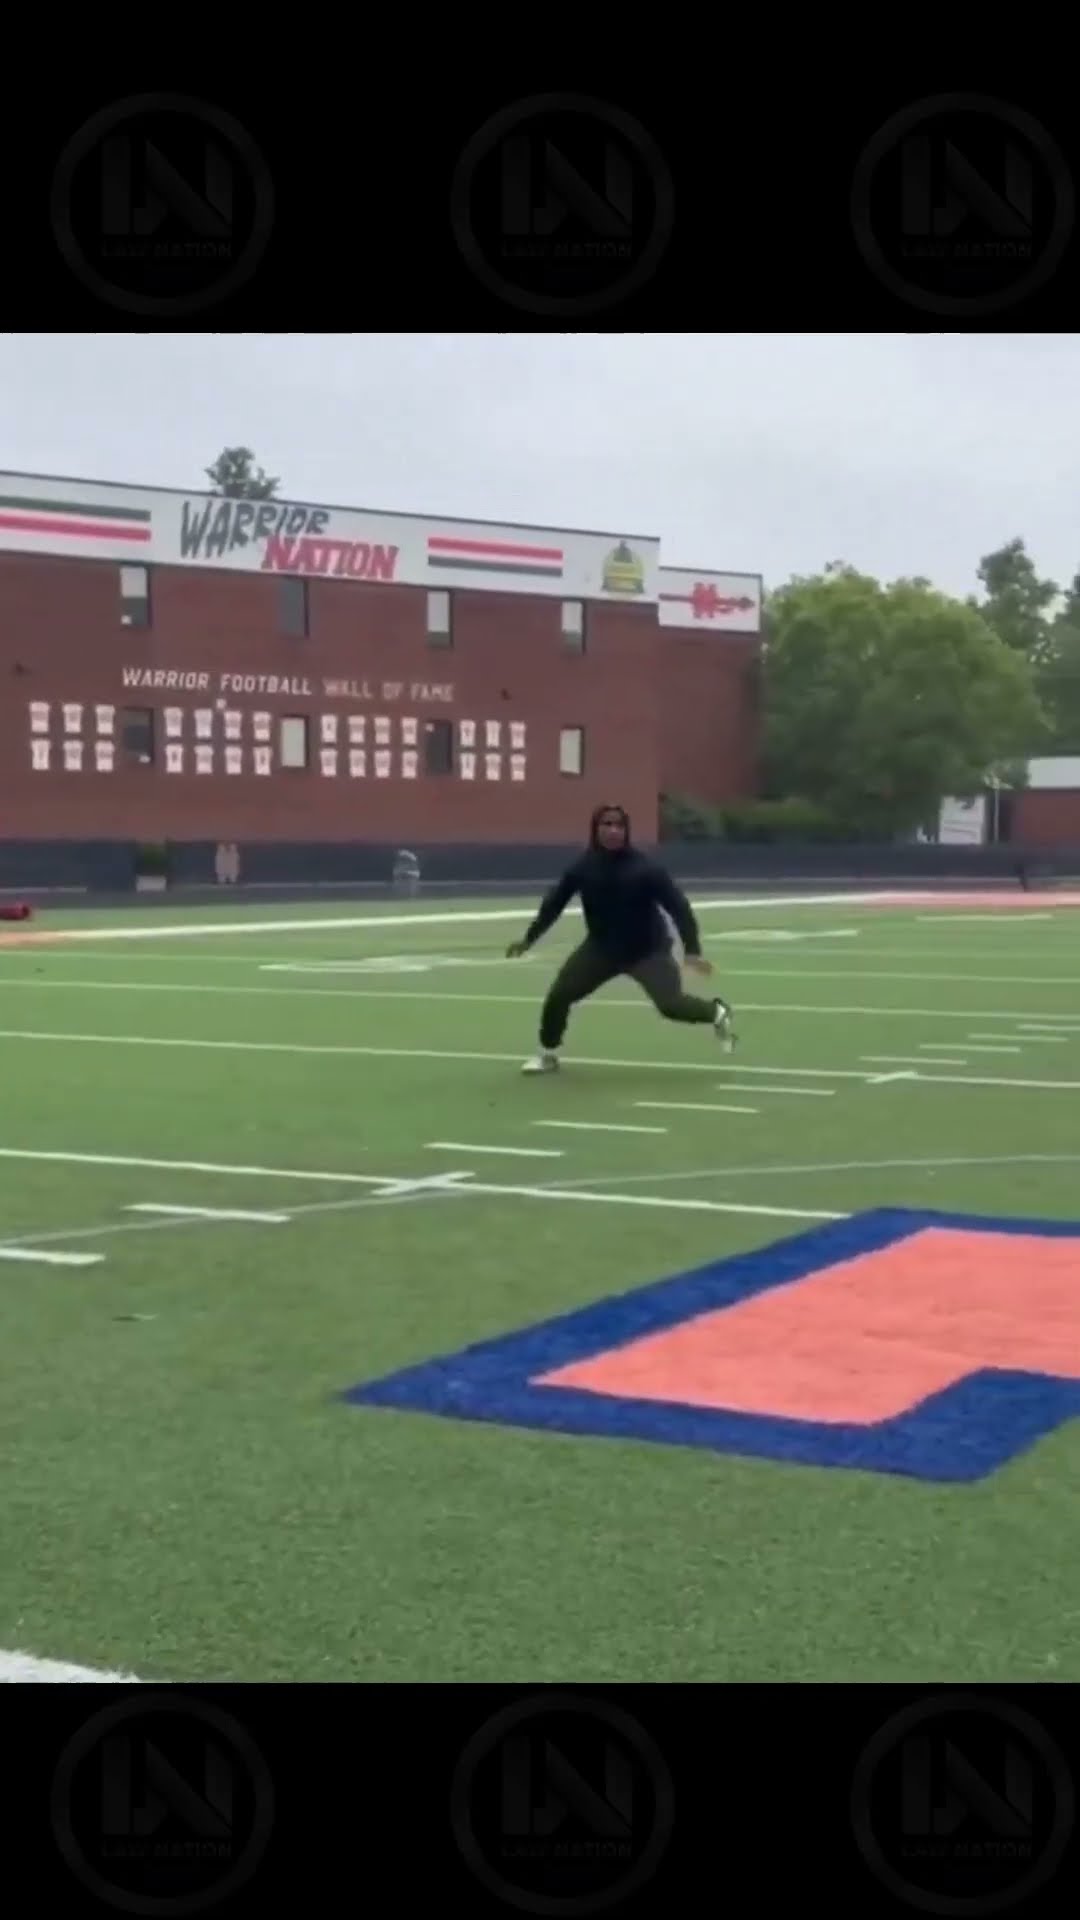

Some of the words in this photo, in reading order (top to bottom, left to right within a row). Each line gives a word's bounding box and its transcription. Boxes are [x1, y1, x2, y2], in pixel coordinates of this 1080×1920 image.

[180, 500, 330, 559] WARRIOR
[261, 534, 400, 580] NATION
[122, 667, 210, 689] WARRIOR
[220, 673, 312, 696] FOOTBALL
[323, 679, 372, 699] WALL
[382, 683, 402, 700] OF
[410, 683, 455, 702] FAME
